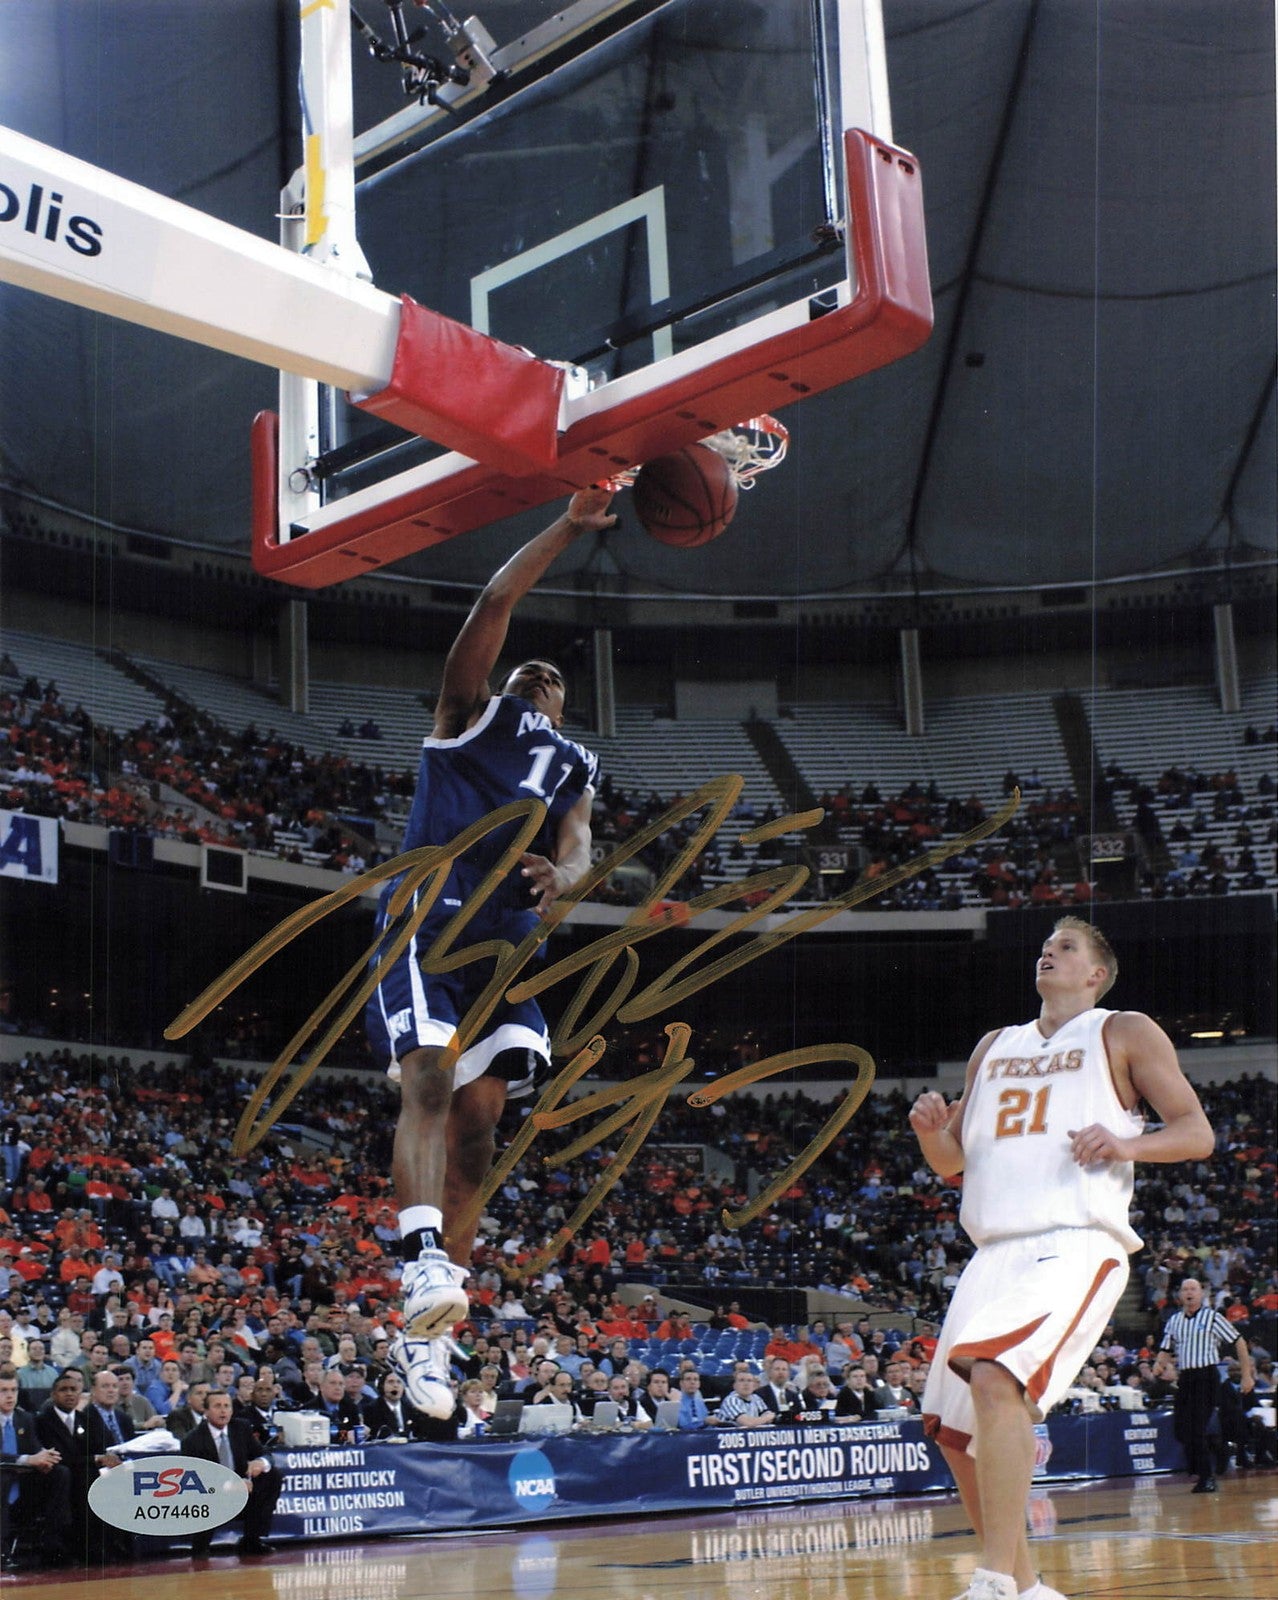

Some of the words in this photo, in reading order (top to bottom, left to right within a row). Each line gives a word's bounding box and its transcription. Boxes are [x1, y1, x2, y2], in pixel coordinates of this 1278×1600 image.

[1092, 839, 1125, 856] 332
[820, 852, 848, 868] 331
[987, 1048, 1086, 1082] TEXAS
[994, 1083, 1053, 1140] 21
[799, 1410, 823, 1422] POSS
[717, 1432, 746, 1449] 2005
[747, 1430, 796, 1447] DIVISION
[797, 1429, 803, 1444] I
[803, 1428, 838, 1444] MEN'S
[287, 1450, 365, 1469] CINCINNATI
[687, 1446, 845, 1488] FIRST/SECOND
[850, 1441, 931, 1476] ROUNDS
[326, 1470, 396, 1489] KENTUCKY
[515, 1478, 556, 1497] NCAA
[273, 1496, 326, 1514] RLEIGH
[330, 1491, 405, 1511] DICKINSON
[304, 1516, 364, 1535] ILLINOIS
